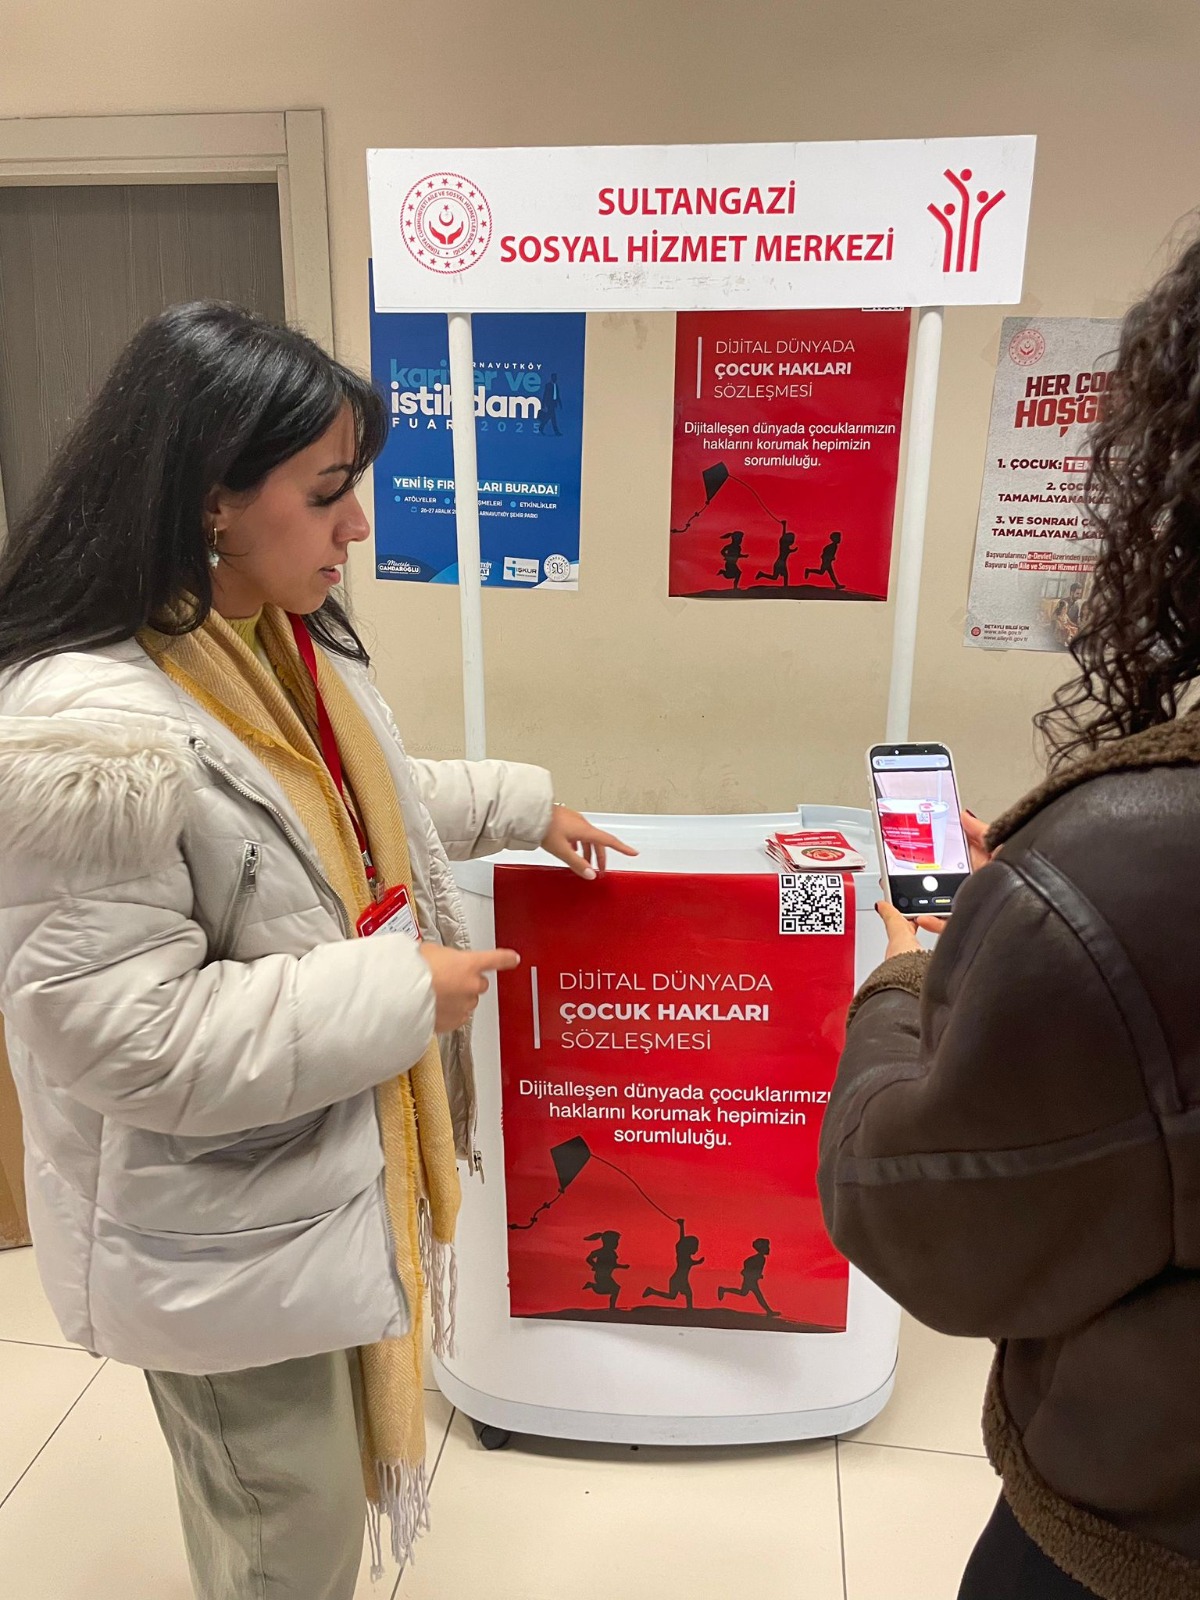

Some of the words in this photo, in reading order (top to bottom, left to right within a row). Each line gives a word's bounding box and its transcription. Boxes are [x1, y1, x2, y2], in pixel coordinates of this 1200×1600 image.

[598, 180, 795, 216] SULTANGAZİ
[500, 235, 618, 263] SOSYAL
[627, 229, 747, 263] HİZMET
[755, 227, 894, 262] MERKEZİ
[716, 339, 772, 354] DİJİTAL
[776, 338, 855, 354] DÜNYADA
[472, 361, 542, 370] RNAVUTKÖY
[714, 362, 774, 380] ÇOCUK
[779, 362, 852, 376] HAKLARI
[390, 358, 497, 390] karier
[505, 371, 541, 393] ve
[714, 382, 813, 401] SÖZLEŞMESİ
[1025, 374, 1071, 398] HER
[684, 421, 750, 438] Dijitalleşen
[753, 421, 805, 439] dünyada
[808, 422, 896, 439] çocuklarımızın
[703, 438, 753, 450] haklarını
[757, 438, 809, 450] korumak
[812, 439, 871, 453] hepimizin
[744, 454, 822, 469] sorumluluğu.
[997, 458, 1007, 469] 1.
[1010, 458, 1063, 471] ÇOCUK:
[393, 476, 421, 488] YENİ
[423, 476, 434, 491] İŞ
[437, 480, 502, 493] FIRLARI
[505, 482, 558, 495] BURADA!
[1046, 482, 1057, 490] 2.
[404, 496, 437, 504] ATÖLYELER
[519, 501, 557, 509] ETKİNLİKLER
[995, 515, 1005, 525] 3.
[1008, 516, 1024, 525] VE
[1026, 516, 1079, 527] SONRAKİ
[992, 528, 1078, 539] TAMAMLAYANA
[1038, 563, 1057, 571] Sosyal
[559, 969, 646, 991] DİJİTAL
[652, 970, 774, 992] DÜNYADA
[559, 1002, 651, 1025] ÇOCUK
[657, 1003, 770, 1022] HAKLARI
[560, 1029, 712, 1054] SÖZLEŞMESİ
[519, 1079, 619, 1100] Dijitalleşen
[624, 1083, 705, 1103] dünyada
[549, 1102, 626, 1120] haklarını
[632, 1106, 711, 1122] korumak
[717, 1109, 807, 1127] hepimizin
[613, 1127, 733, 1149] sorumluluğu.
